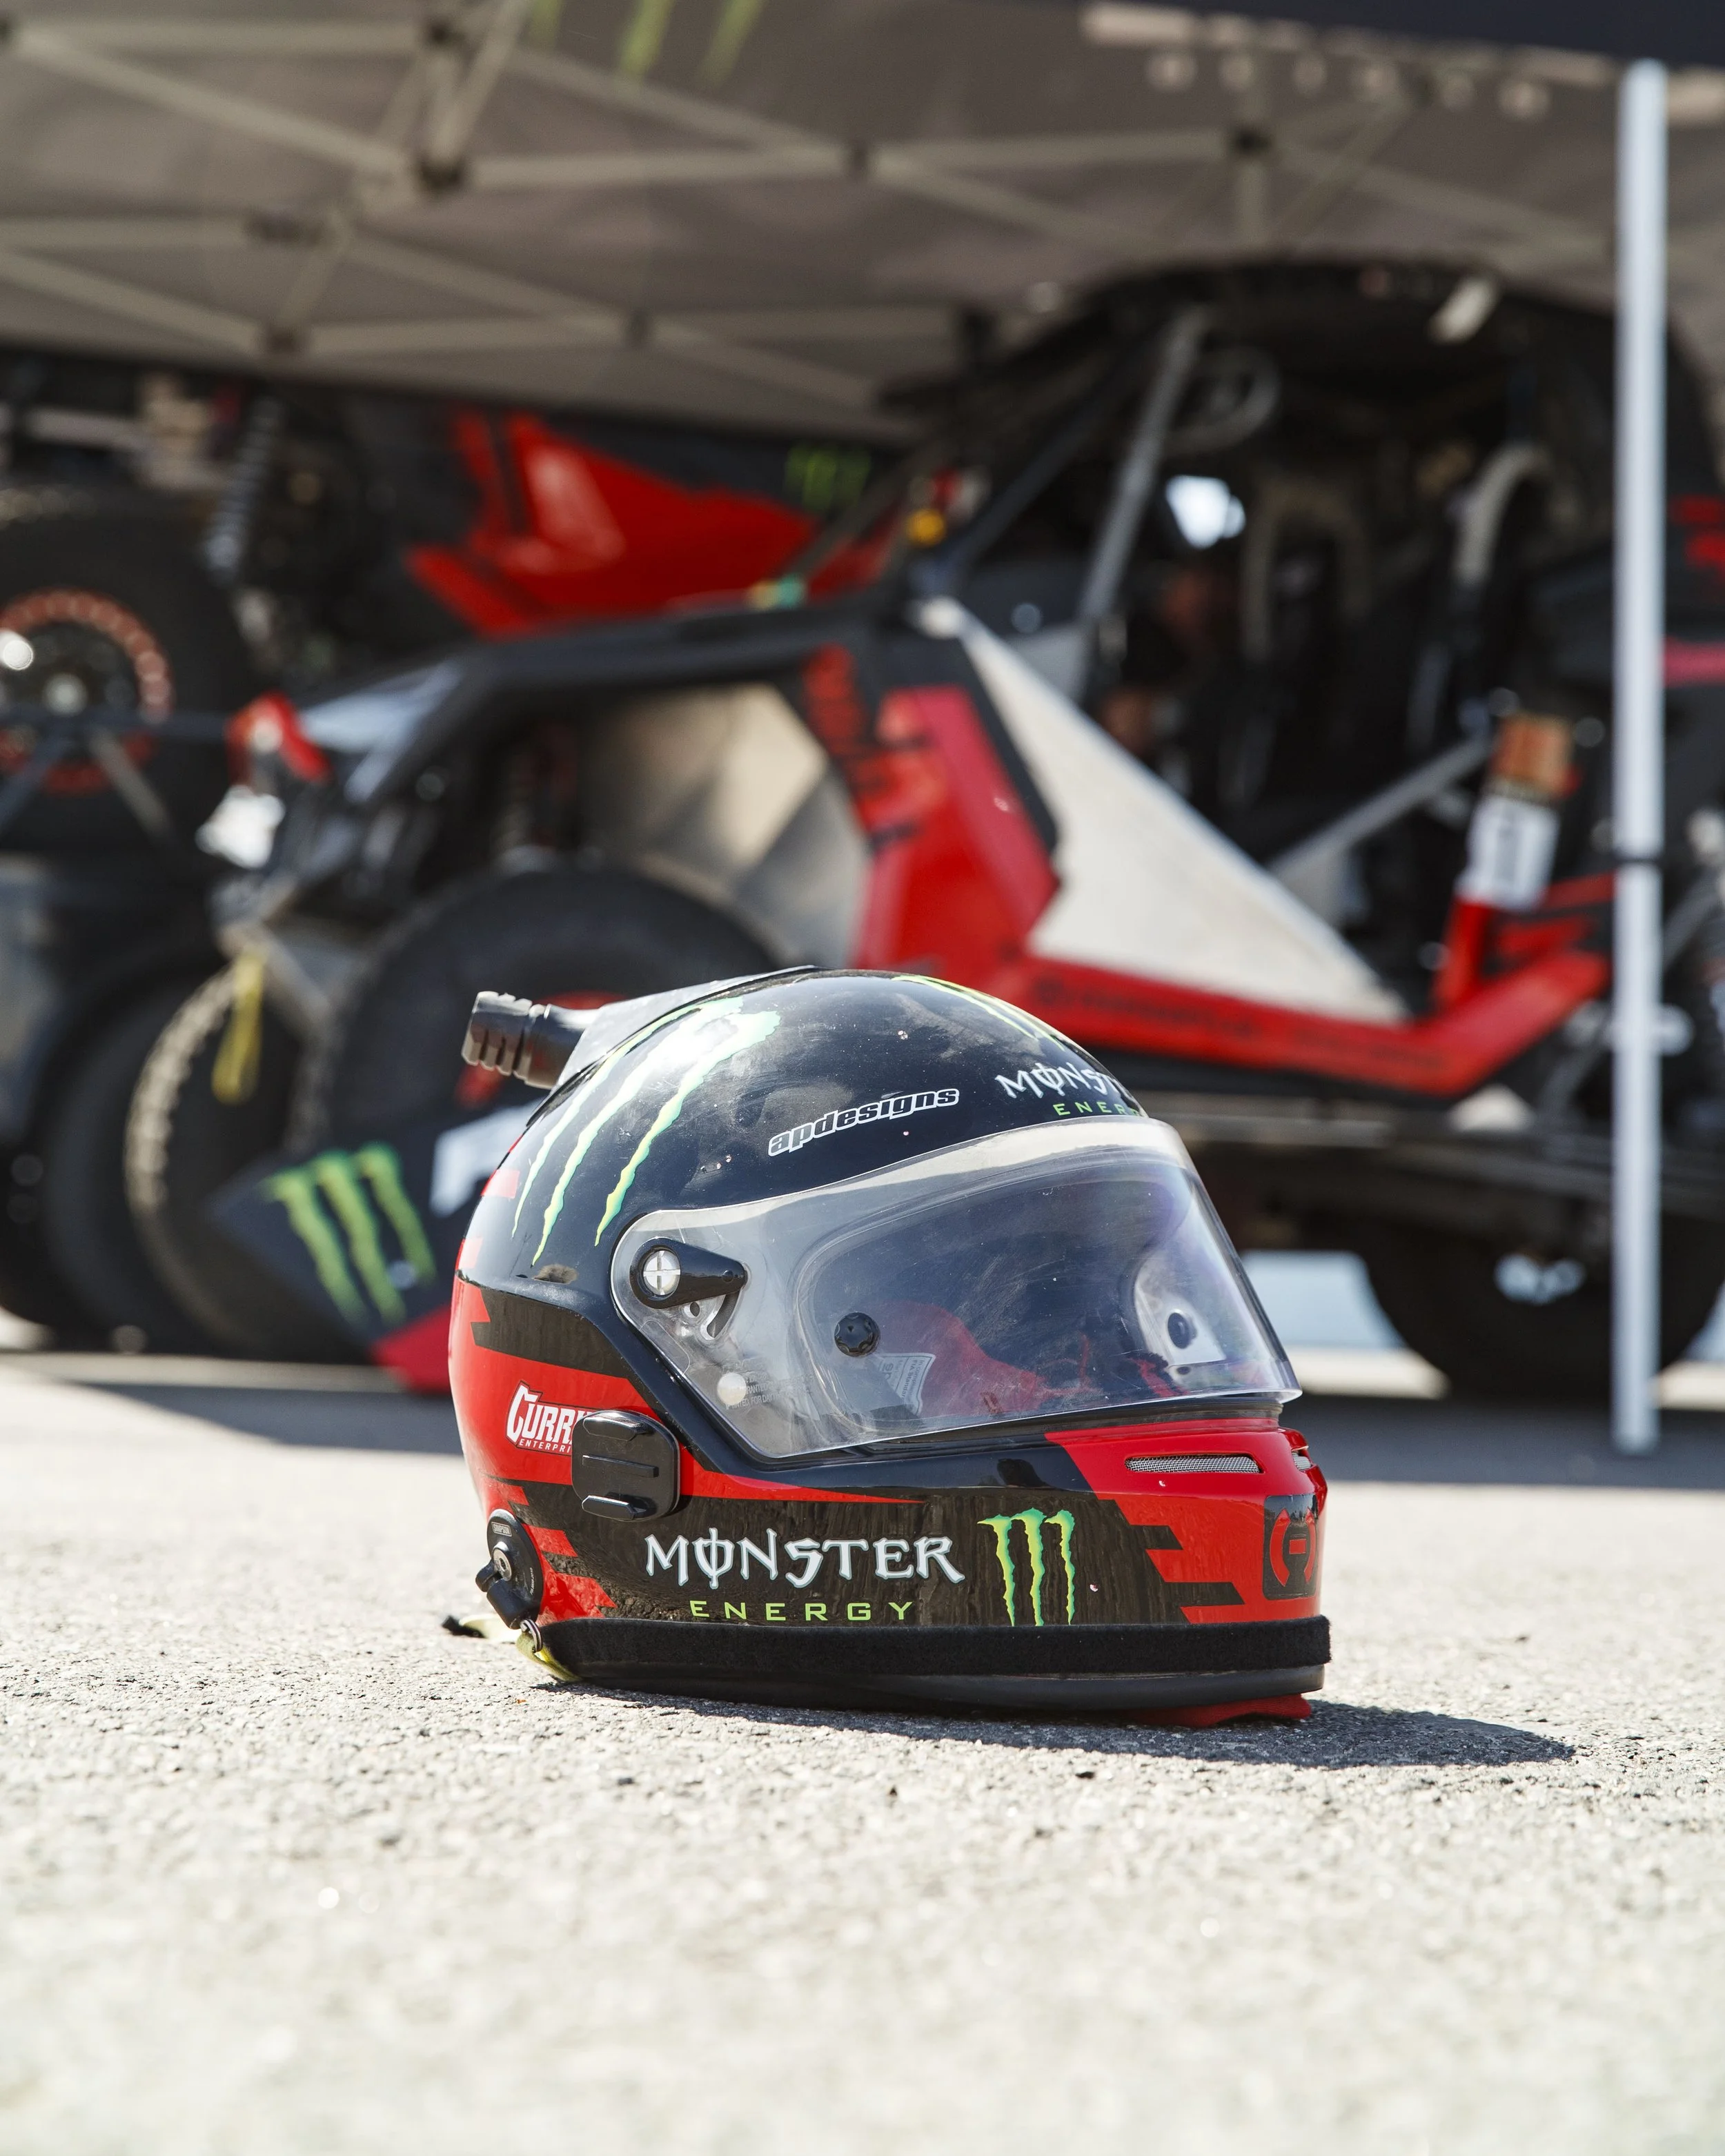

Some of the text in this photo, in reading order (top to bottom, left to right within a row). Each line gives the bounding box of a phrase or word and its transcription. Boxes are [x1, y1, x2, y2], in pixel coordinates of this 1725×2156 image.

[768, 1088, 960, 1156] apdesigns
[644, 1527, 965, 1589] MONSTER
[690, 1600, 913, 1621] ENERGY
